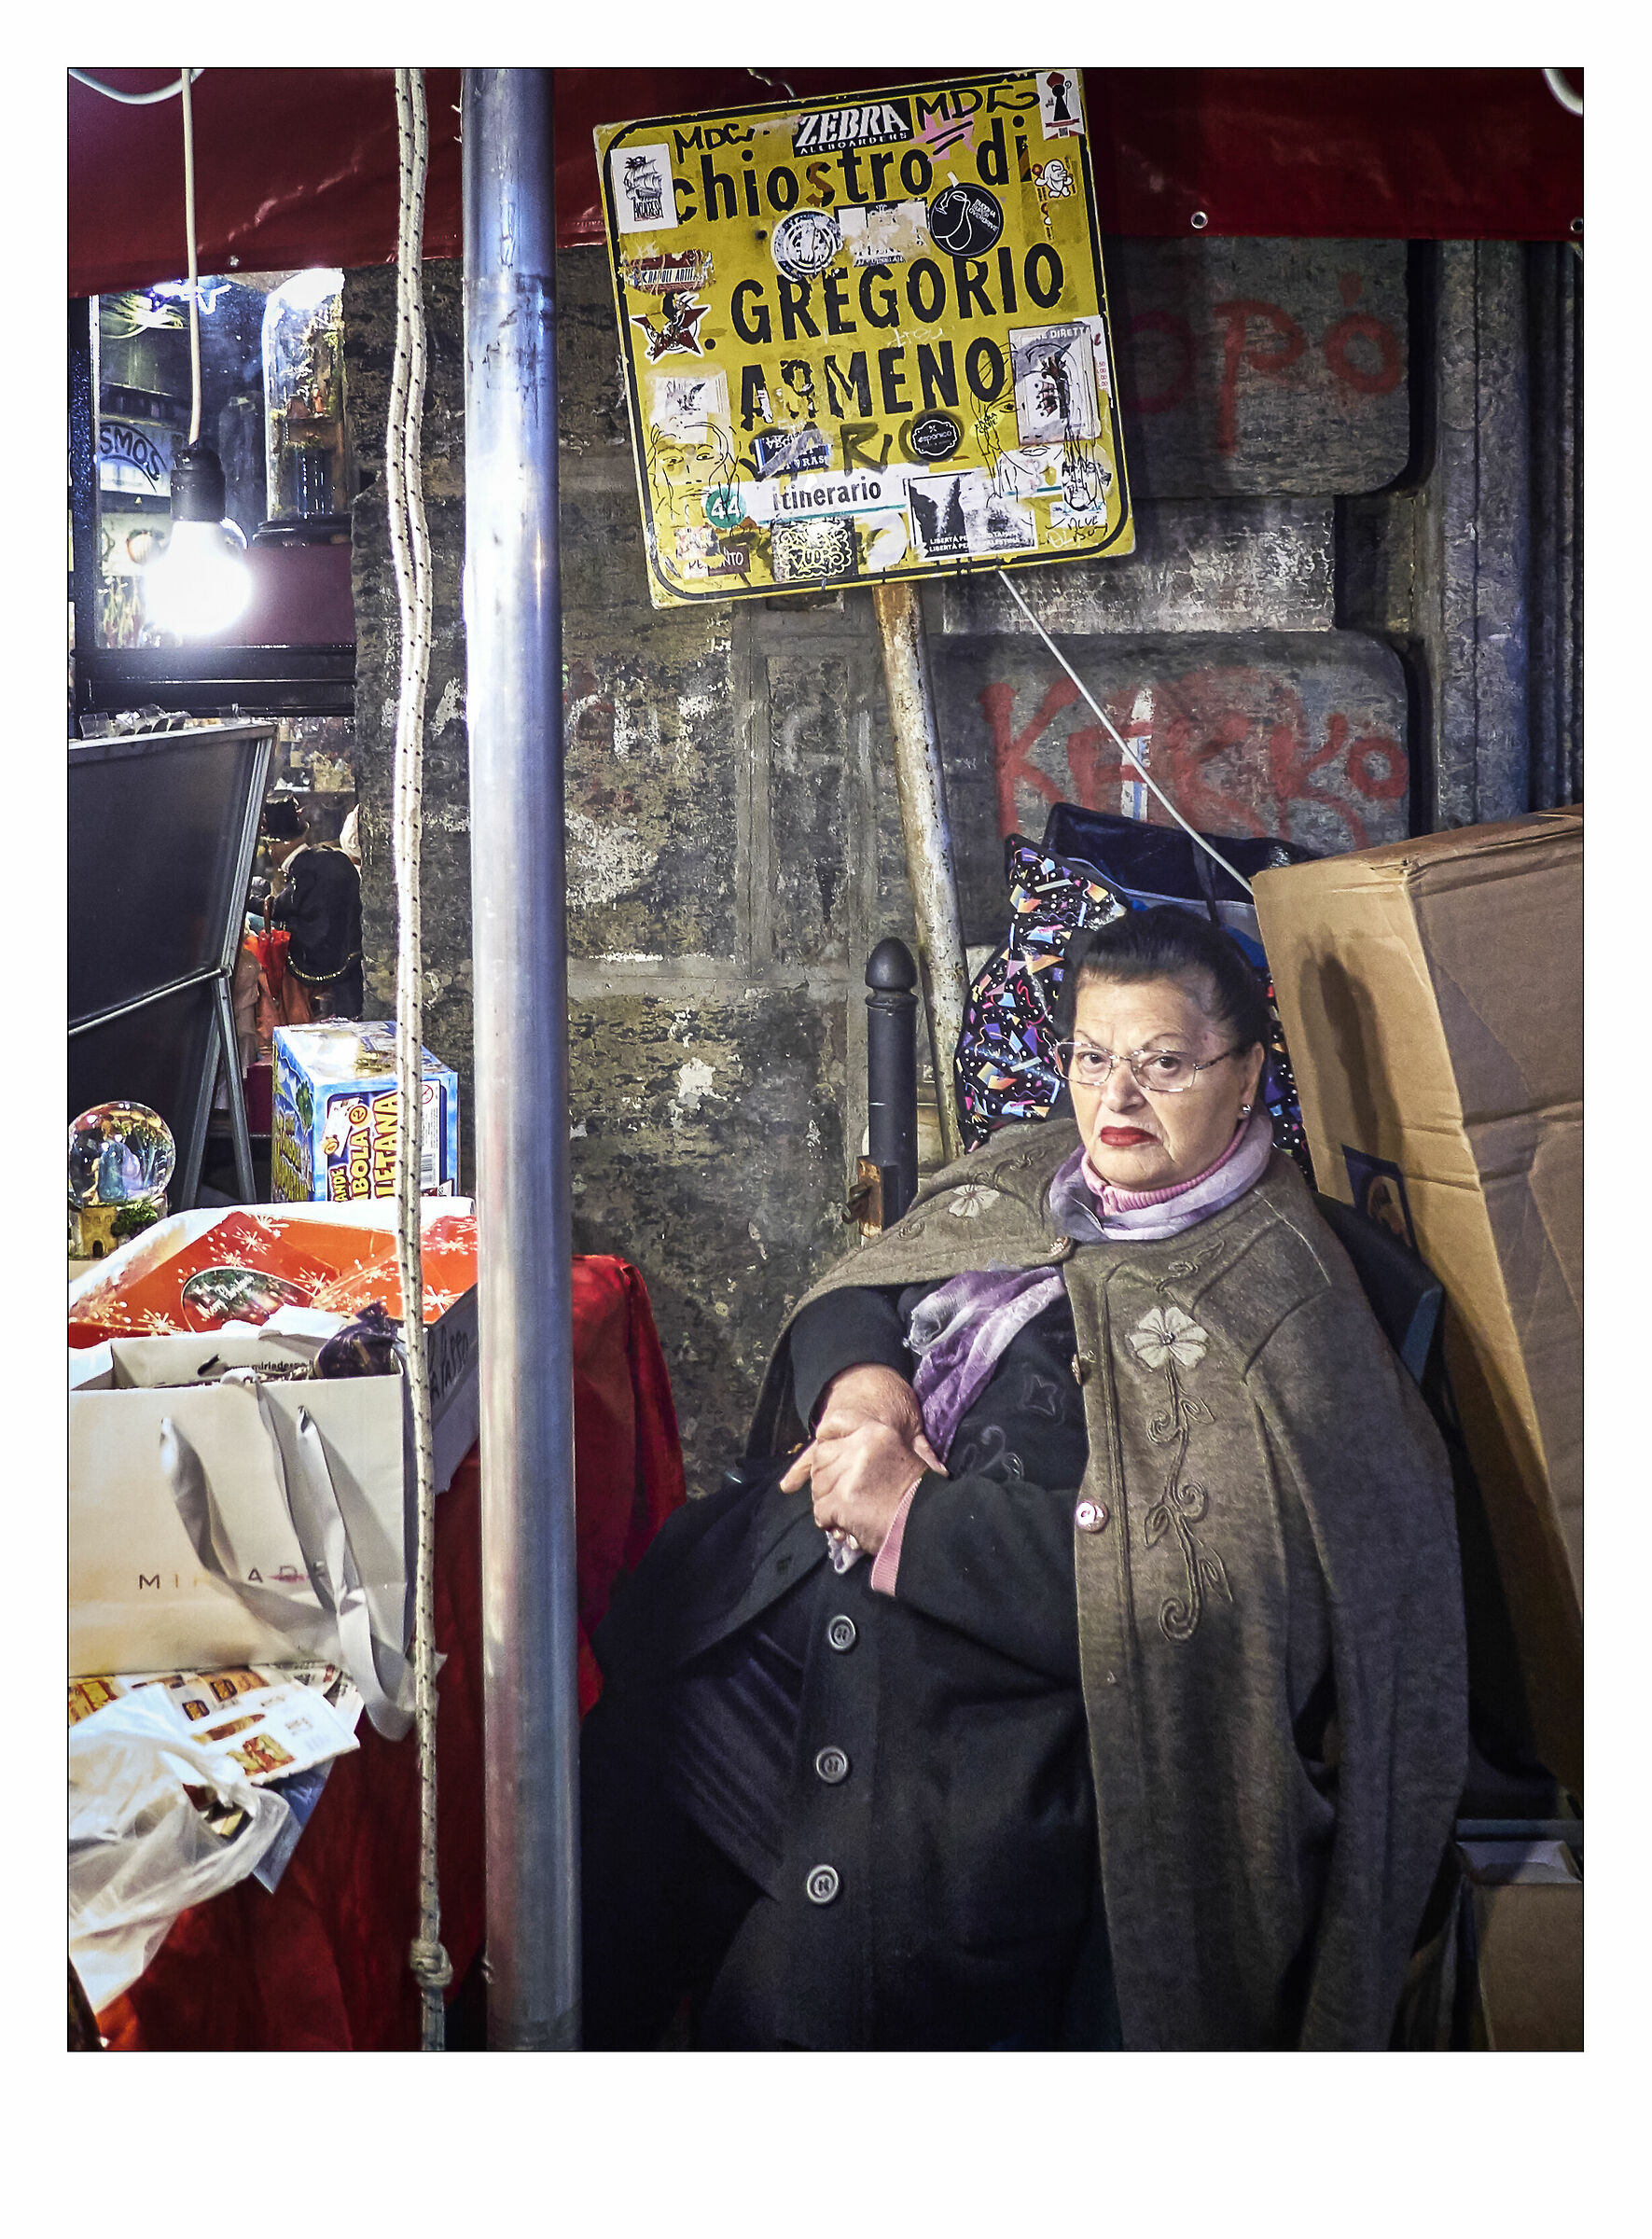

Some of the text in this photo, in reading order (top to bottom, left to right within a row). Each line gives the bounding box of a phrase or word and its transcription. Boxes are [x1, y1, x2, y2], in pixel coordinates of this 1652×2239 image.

[795, 103, 910, 148] ZEBRA
[672, 114, 1034, 225] chiostro di
[730, 242, 1064, 344] GREGORIO
[740, 336, 1006, 431] ARMENO
[711, 476, 882, 520] 44 itinerario
[350, 1127, 371, 1201] BOLA
[373, 1091, 398, 1199] LETANA
[331, 1165, 350, 1202] ANDE
[139, 1561, 326, 1590] MIADE
